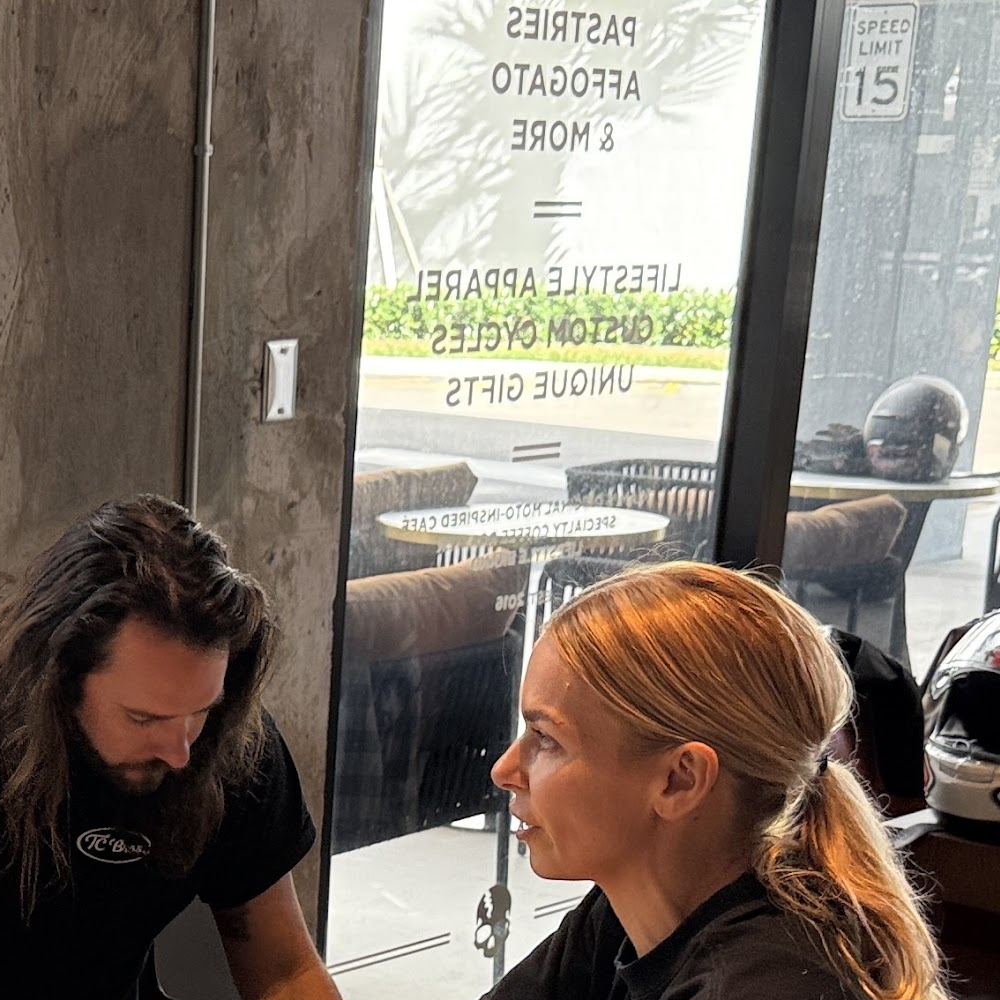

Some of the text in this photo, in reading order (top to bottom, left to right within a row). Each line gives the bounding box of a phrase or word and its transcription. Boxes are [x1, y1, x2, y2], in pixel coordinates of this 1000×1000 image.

[856, 18, 911, 35] SPEED
[858, 39, 903, 56] LIMIT
[855, 65, 899, 106] 15
